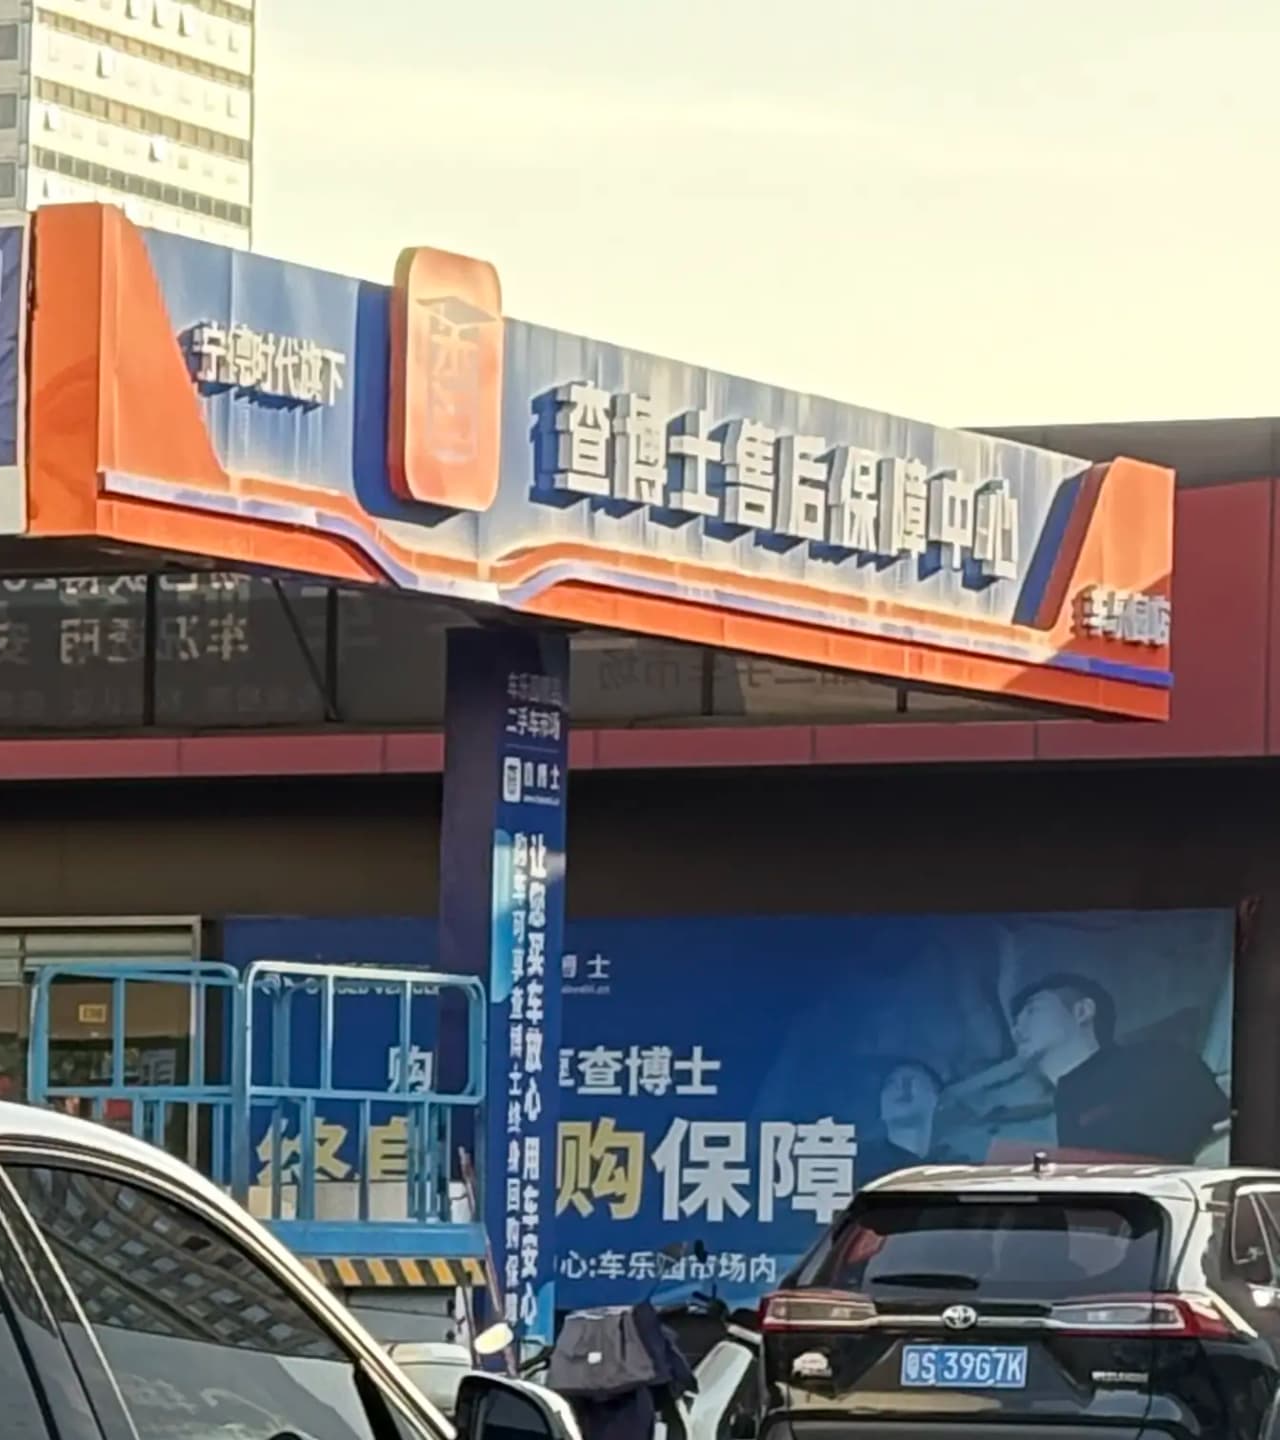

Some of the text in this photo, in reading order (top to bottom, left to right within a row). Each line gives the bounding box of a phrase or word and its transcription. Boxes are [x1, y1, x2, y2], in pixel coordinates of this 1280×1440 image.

[194, 318, 346, 407] 宁德时代旗下
[556, 380, 1019, 580] 查博士售后保障中心
[523, 833, 547, 1122] 让您买车放心
[520, 1136, 541, 1327] 用车安心
[555, 1117, 858, 1224] 购保障
[553, 1249, 777, 1284] 心:车乐园市场内
